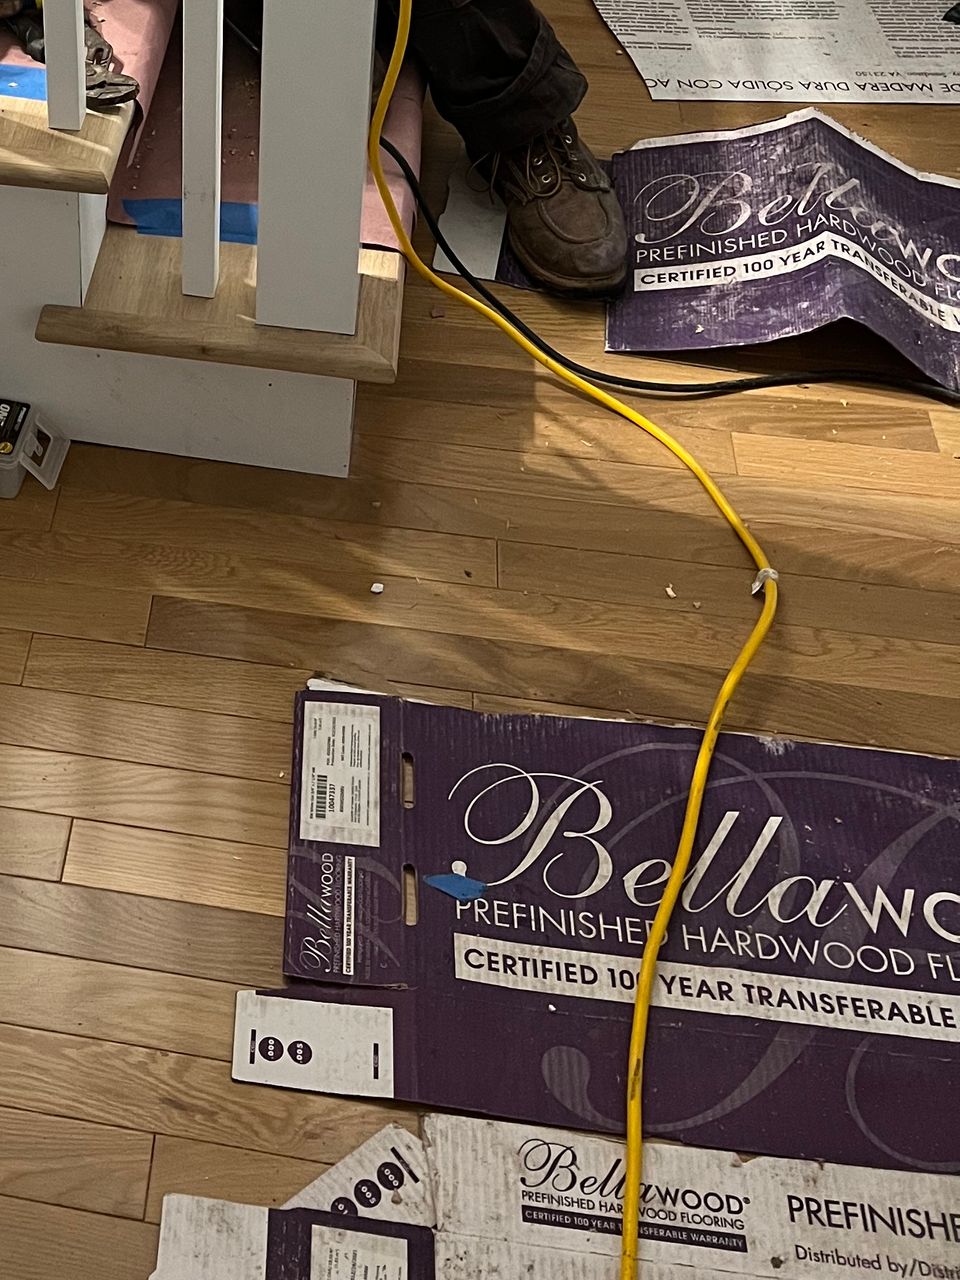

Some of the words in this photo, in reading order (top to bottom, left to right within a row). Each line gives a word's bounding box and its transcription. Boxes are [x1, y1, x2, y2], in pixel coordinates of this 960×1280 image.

[677, 78, 723, 89] CON
[727, 79, 794, 93] SÓLIDA
[798, 80, 850, 92] DURA
[854, 81, 934, 93] MADERA
[636, 228, 788, 264] PREFINISHED
[796, 212, 927, 288] HARDWOOD
[640, 265, 737, 285] CERTIFIED
[743, 258, 774, 274] 100
[782, 240, 825, 268] YEAR
[830, 237, 946, 322] TRANSFERABLE
[681, 923, 916, 976] HARDWOOD
[463, 948, 599, 986] CERTIFIED
[607, 967, 643, 991] 10
[658, 973, 735, 1002] YEAR
[741, 983, 957, 1029] TRANSFERABLE
[521, 1189, 596, 1211] PREFINISHED
[598, 1200, 677, 1222] HARWOOD
[680, 1211, 745, 1231] FLOORING
[524, 1210, 572, 1224] CERTIFIED
[573, 1215, 590, 1228] 100
[591, 1219, 616, 1231] YEAR
[617, 1222, 688, 1241] TSFERABLE
[690, 1232, 744, 1248] WARRANTY
[794, 1244, 882, 1271] Distributed
